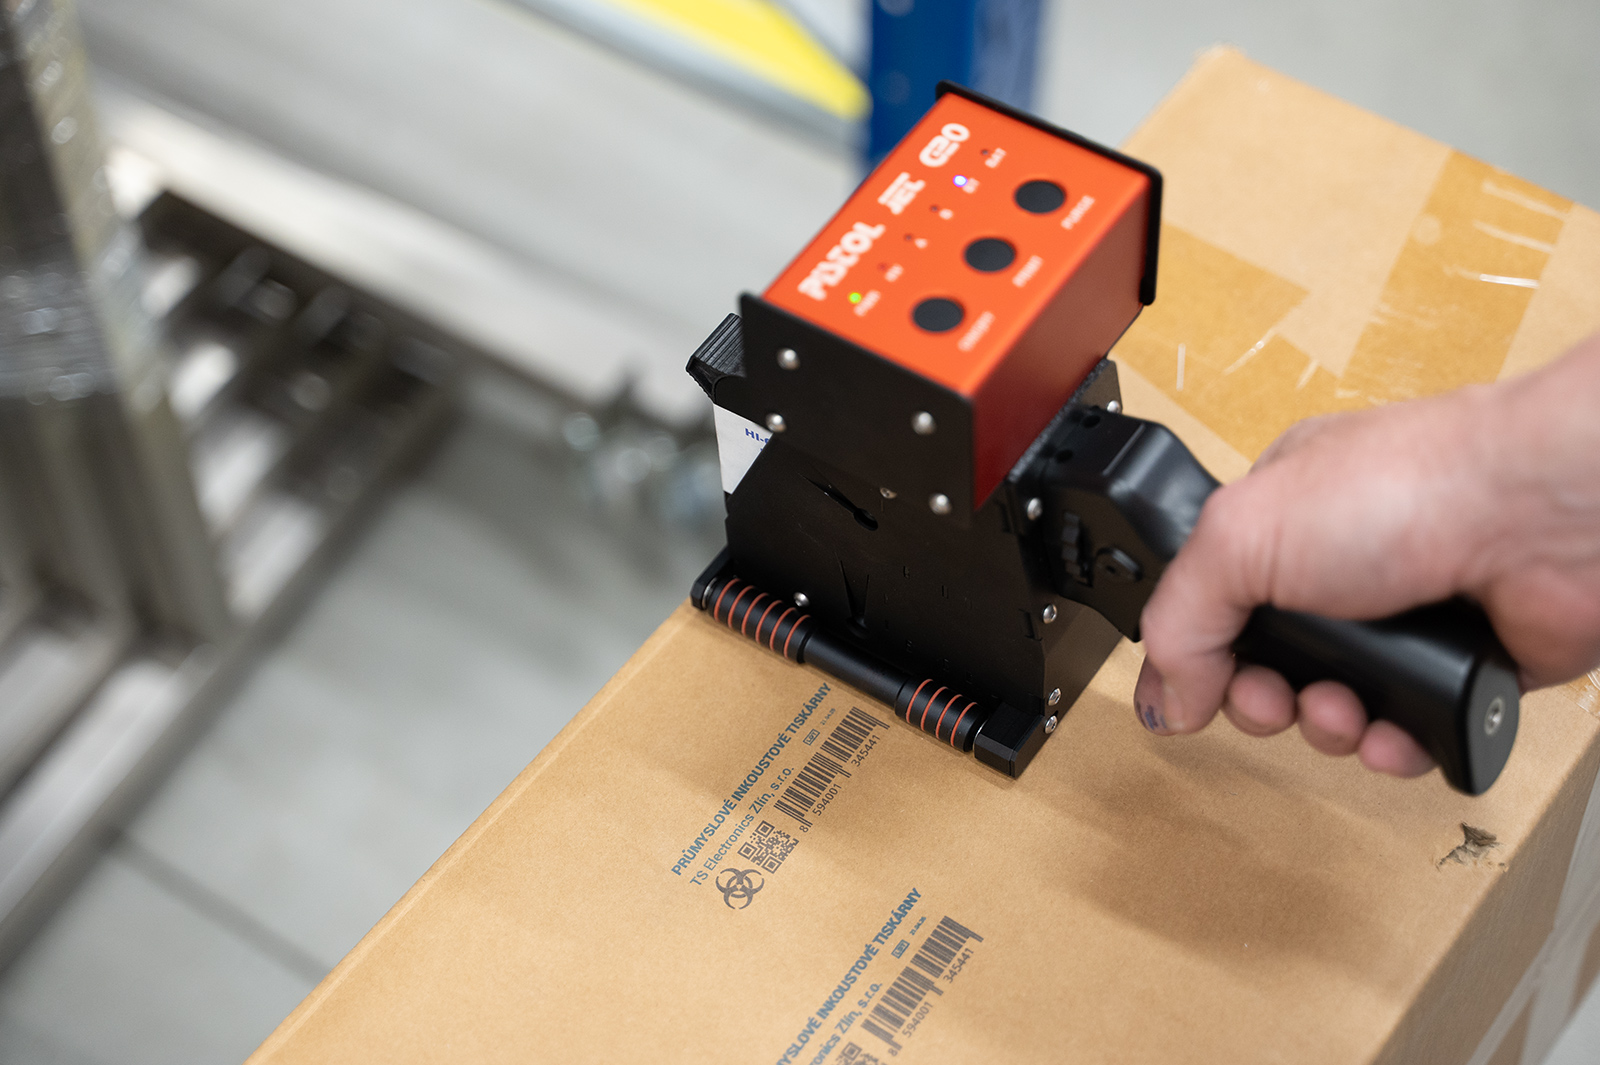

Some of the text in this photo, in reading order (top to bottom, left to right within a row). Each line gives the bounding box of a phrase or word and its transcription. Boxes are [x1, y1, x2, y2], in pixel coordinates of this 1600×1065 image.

[797, 221, 885, 301] PISTOL
[671, 682, 832, 876] PRŮMYSLOVÉ INKOUSTOVÉ TISKÁRNY
[689, 766, 795, 886] TS Electronics Zlín, s.r.o.
[799, 734, 881, 833] 8 594001 345441
[816, 944, 879, 1020] INKOUSTOVÉ
[872, 887, 922, 945] TISKÁRNY
[857, 982, 883, 1009] s.r.o.
[888, 947, 974, 1057] 8 594001 345441
